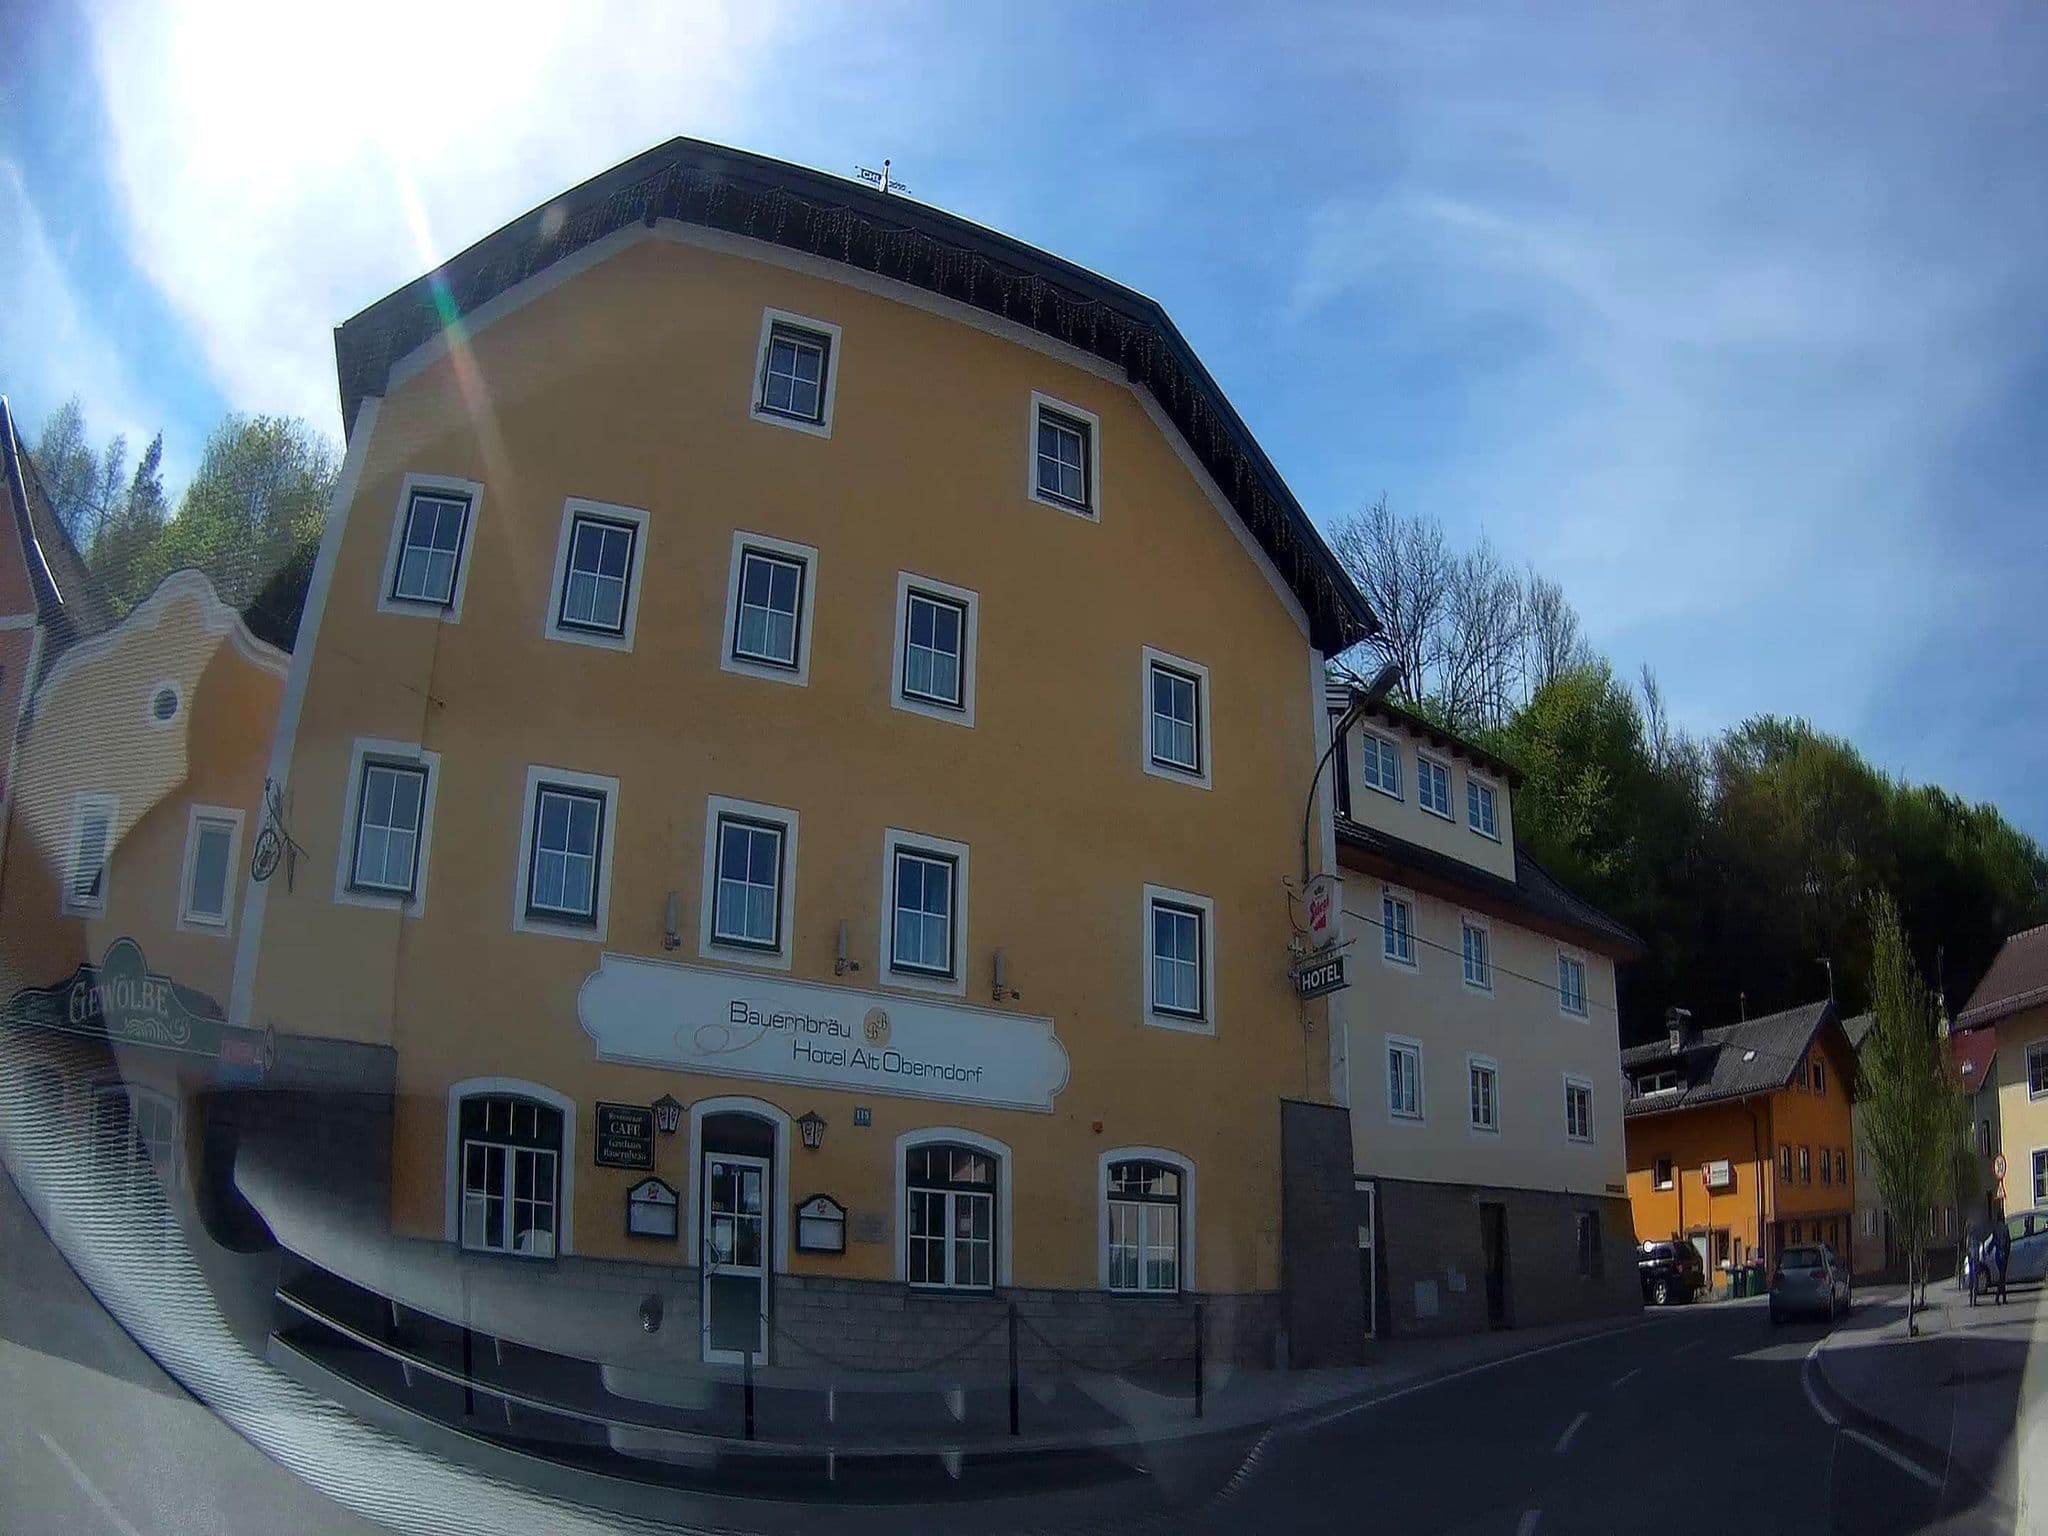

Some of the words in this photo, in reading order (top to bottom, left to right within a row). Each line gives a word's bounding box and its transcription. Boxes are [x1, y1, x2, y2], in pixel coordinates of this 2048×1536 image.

[1302, 963, 1341, 991] HOTEL
[730, 1000, 851, 1038] Bauernbräu
[793, 1040, 846, 1067] Hotel
[850, 1048, 880, 1071] Alt
[882, 1051, 983, 1082] Oberndorf
